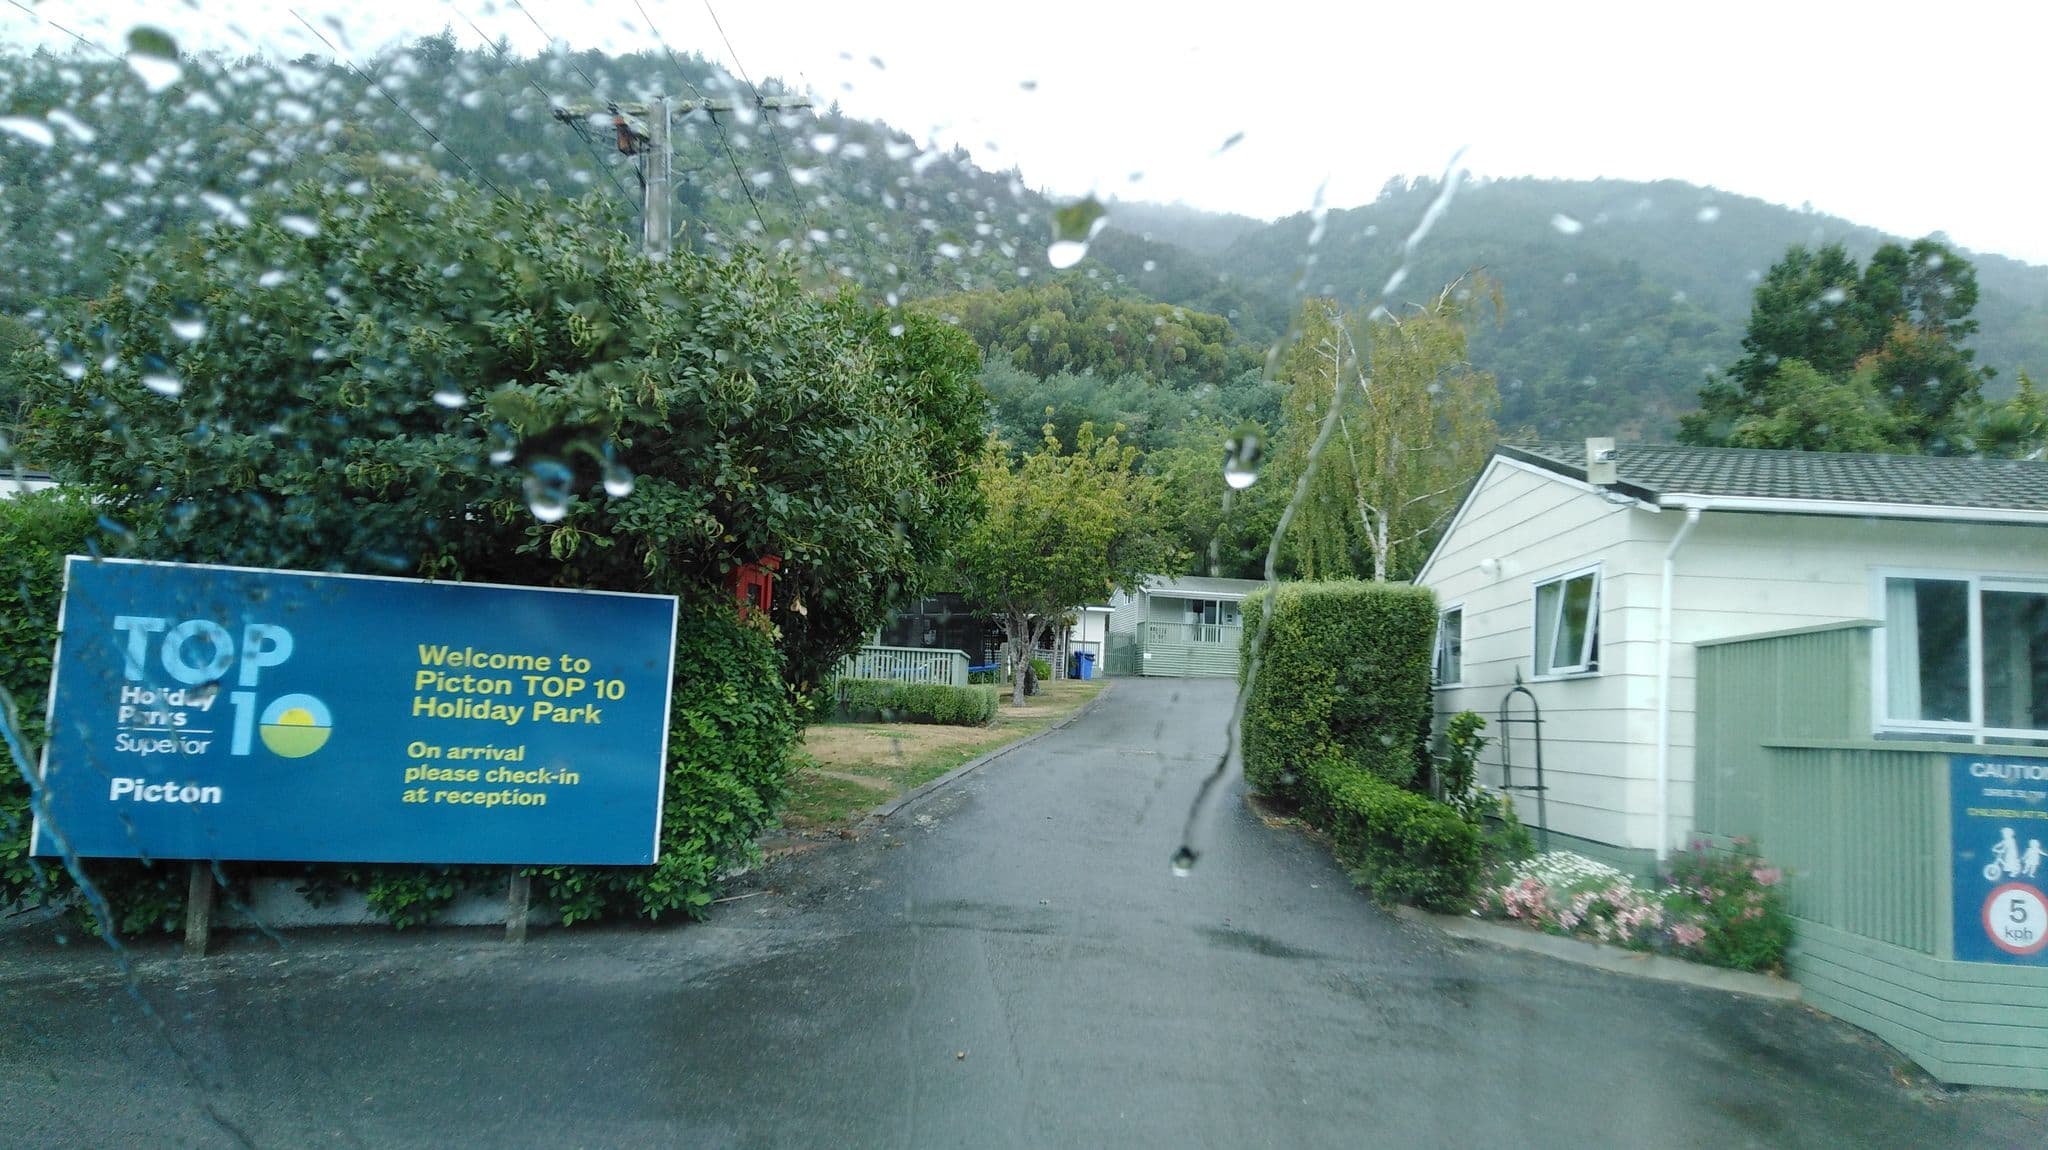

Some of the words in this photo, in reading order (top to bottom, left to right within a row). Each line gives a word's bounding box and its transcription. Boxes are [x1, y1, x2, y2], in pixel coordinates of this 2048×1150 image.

[114, 615, 294, 687] TOP
[418, 644, 552, 672] Welcome
[559, 654, 591, 673] to
[120, 685, 216, 711] Hoiday
[415, 671, 513, 696] Picton
[522, 675, 586, 698] TOP
[593, 679, 625, 701] 10
[118, 706, 188, 726] Prks
[412, 696, 525, 726] Holiday
[532, 701, 602, 724] Park
[114, 733, 210, 757] Superior
[407, 741, 441, 759] On
[447, 744, 526, 762] arrival
[404, 764, 480, 783] please
[485, 766, 579, 785] check-in
[110, 777, 222, 804] Picton
[402, 787, 428, 804] at
[434, 789, 547, 808] reception
[2009, 899, 2028, 923] 5
[2005, 926, 2033, 941] kph
